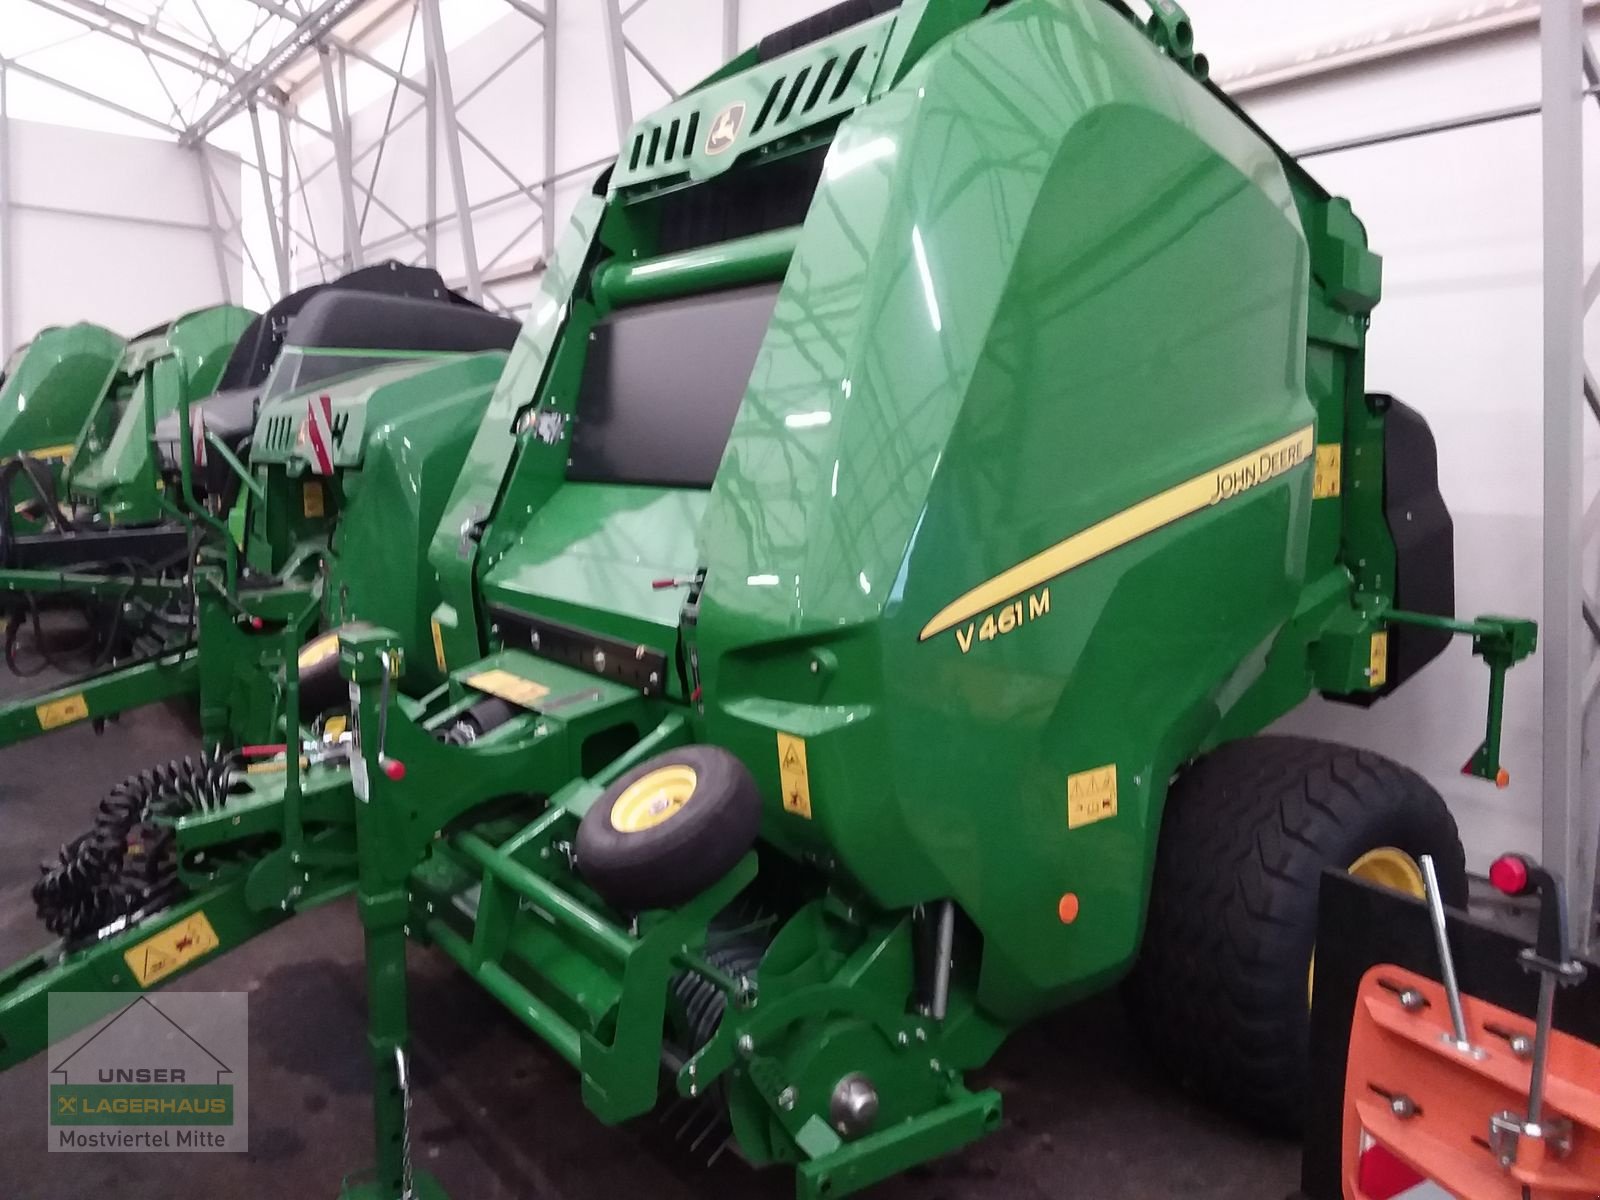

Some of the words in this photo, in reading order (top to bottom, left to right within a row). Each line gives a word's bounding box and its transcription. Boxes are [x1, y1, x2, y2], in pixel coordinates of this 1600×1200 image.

[1210, 473, 1257, 504] JOHN
[1259, 440, 1304, 481] DEERE
[956, 622, 975, 654] V
[979, 600, 1023, 641] 461
[1029, 587, 1050, 621] M
